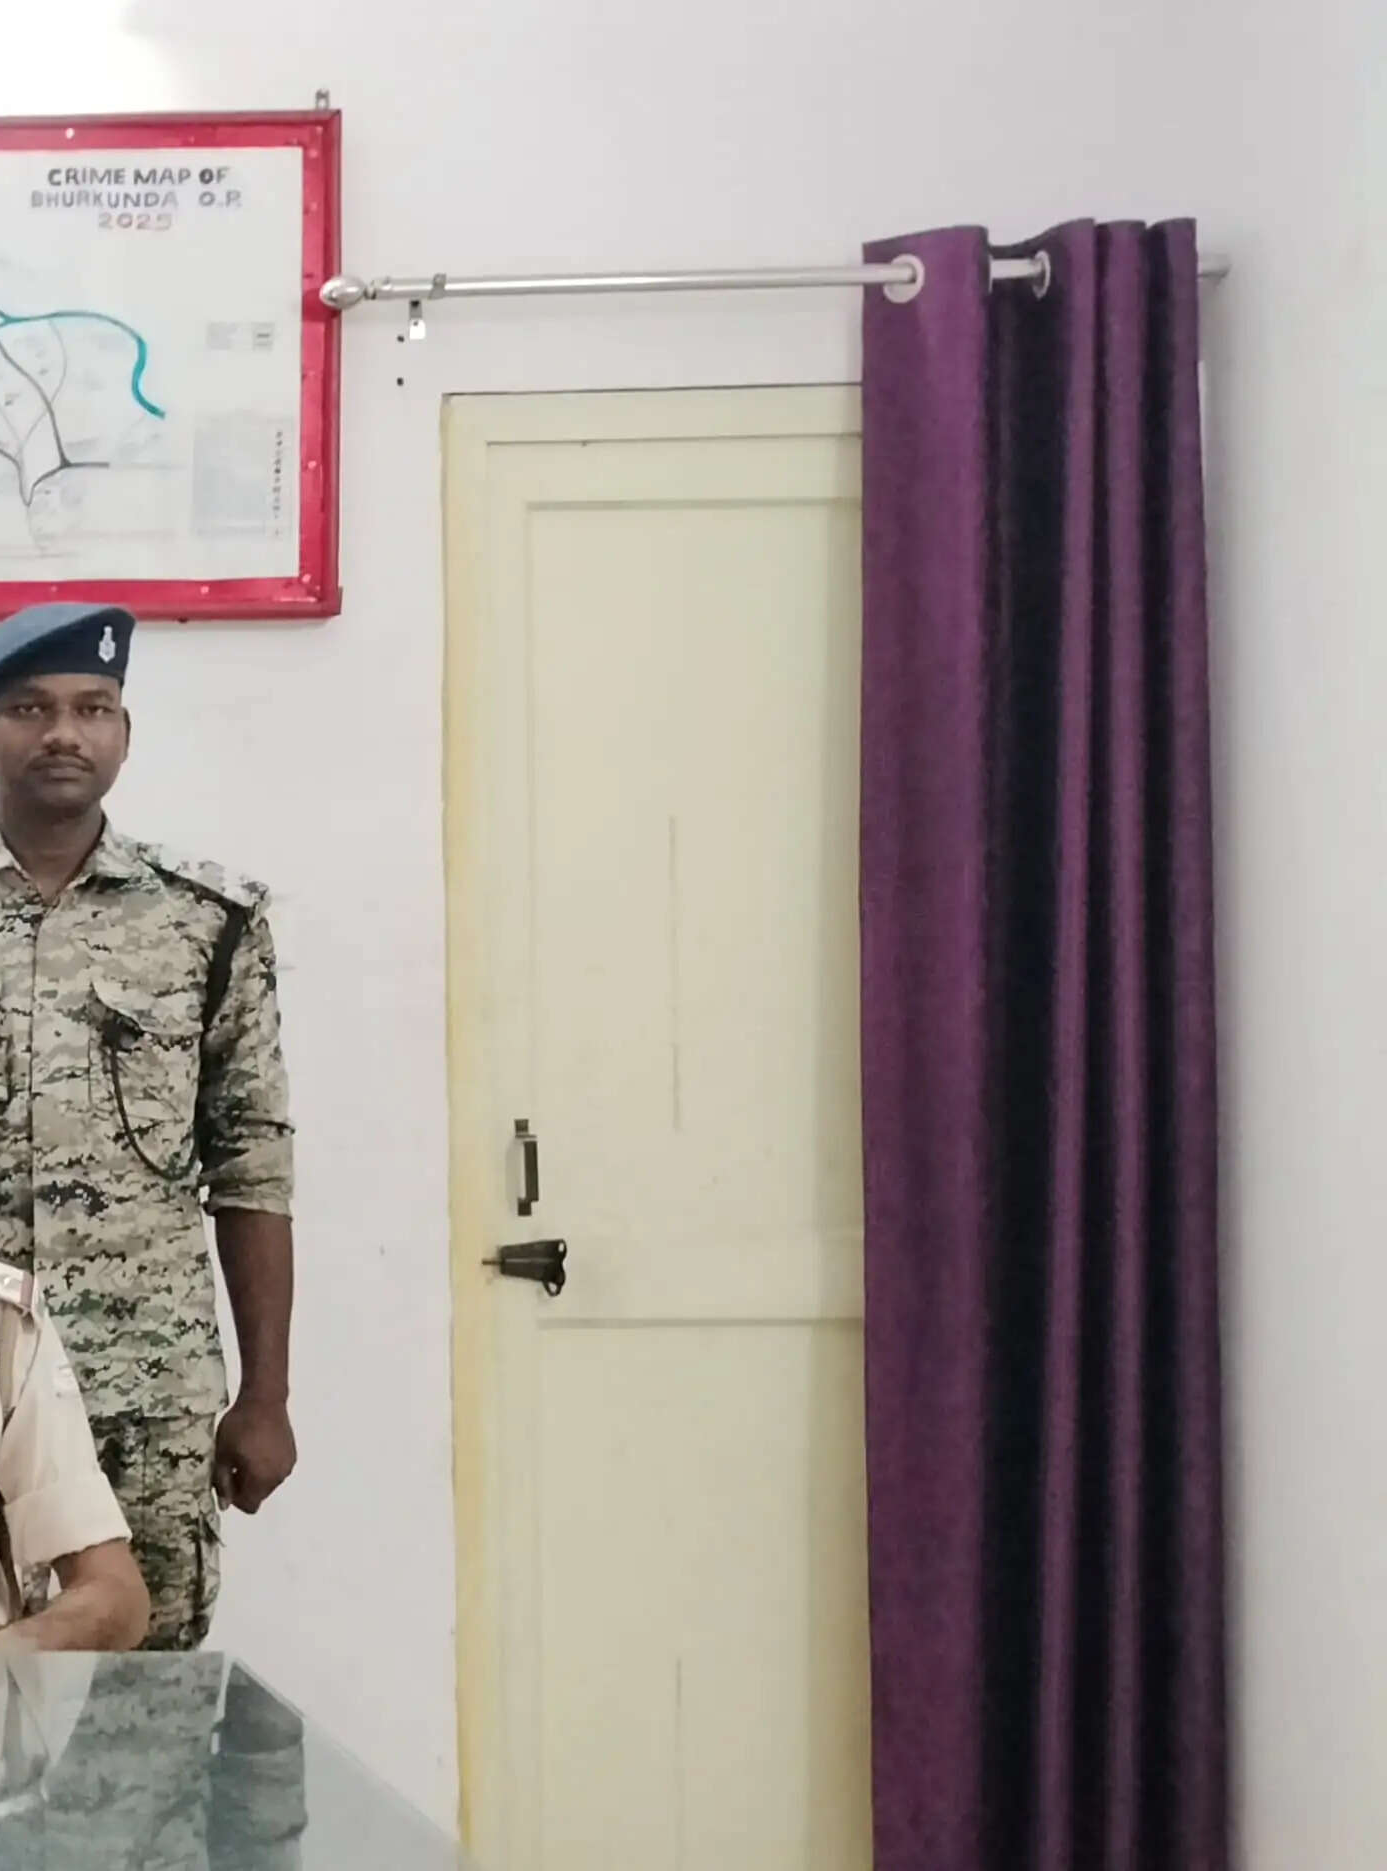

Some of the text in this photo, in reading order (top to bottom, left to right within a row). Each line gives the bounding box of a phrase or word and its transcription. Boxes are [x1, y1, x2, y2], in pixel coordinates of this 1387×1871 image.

[47, 167, 231, 186] CRIME MAP OF
[31, 190, 179, 208] BHURKUNDA
[98, 212, 172, 231] 2025
